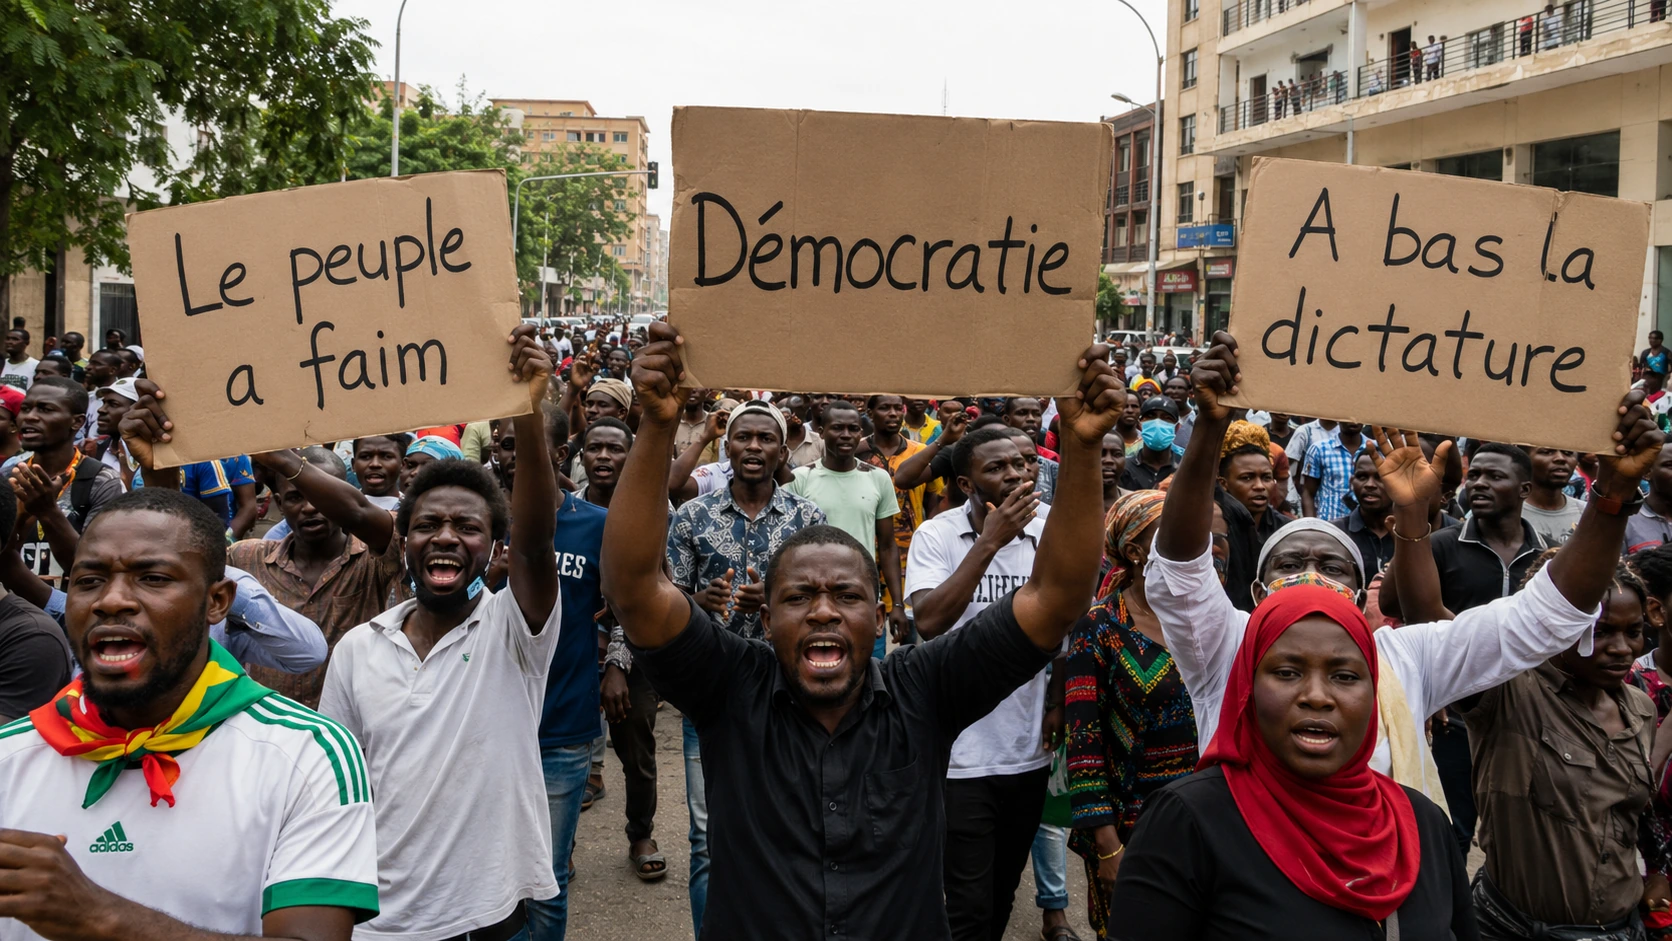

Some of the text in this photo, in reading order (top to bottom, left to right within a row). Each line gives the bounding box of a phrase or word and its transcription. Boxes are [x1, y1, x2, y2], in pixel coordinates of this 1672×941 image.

[174, 196, 472, 326] Le peuple
[690, 191, 1073, 296] Démocratie
[1288, 187, 1596, 291] A bas la
[226, 320, 447, 412] a faim
[1261, 286, 1587, 393] dictature
[554, 550, 587, 579] ES
[89, 842, 134, 853] adidas
